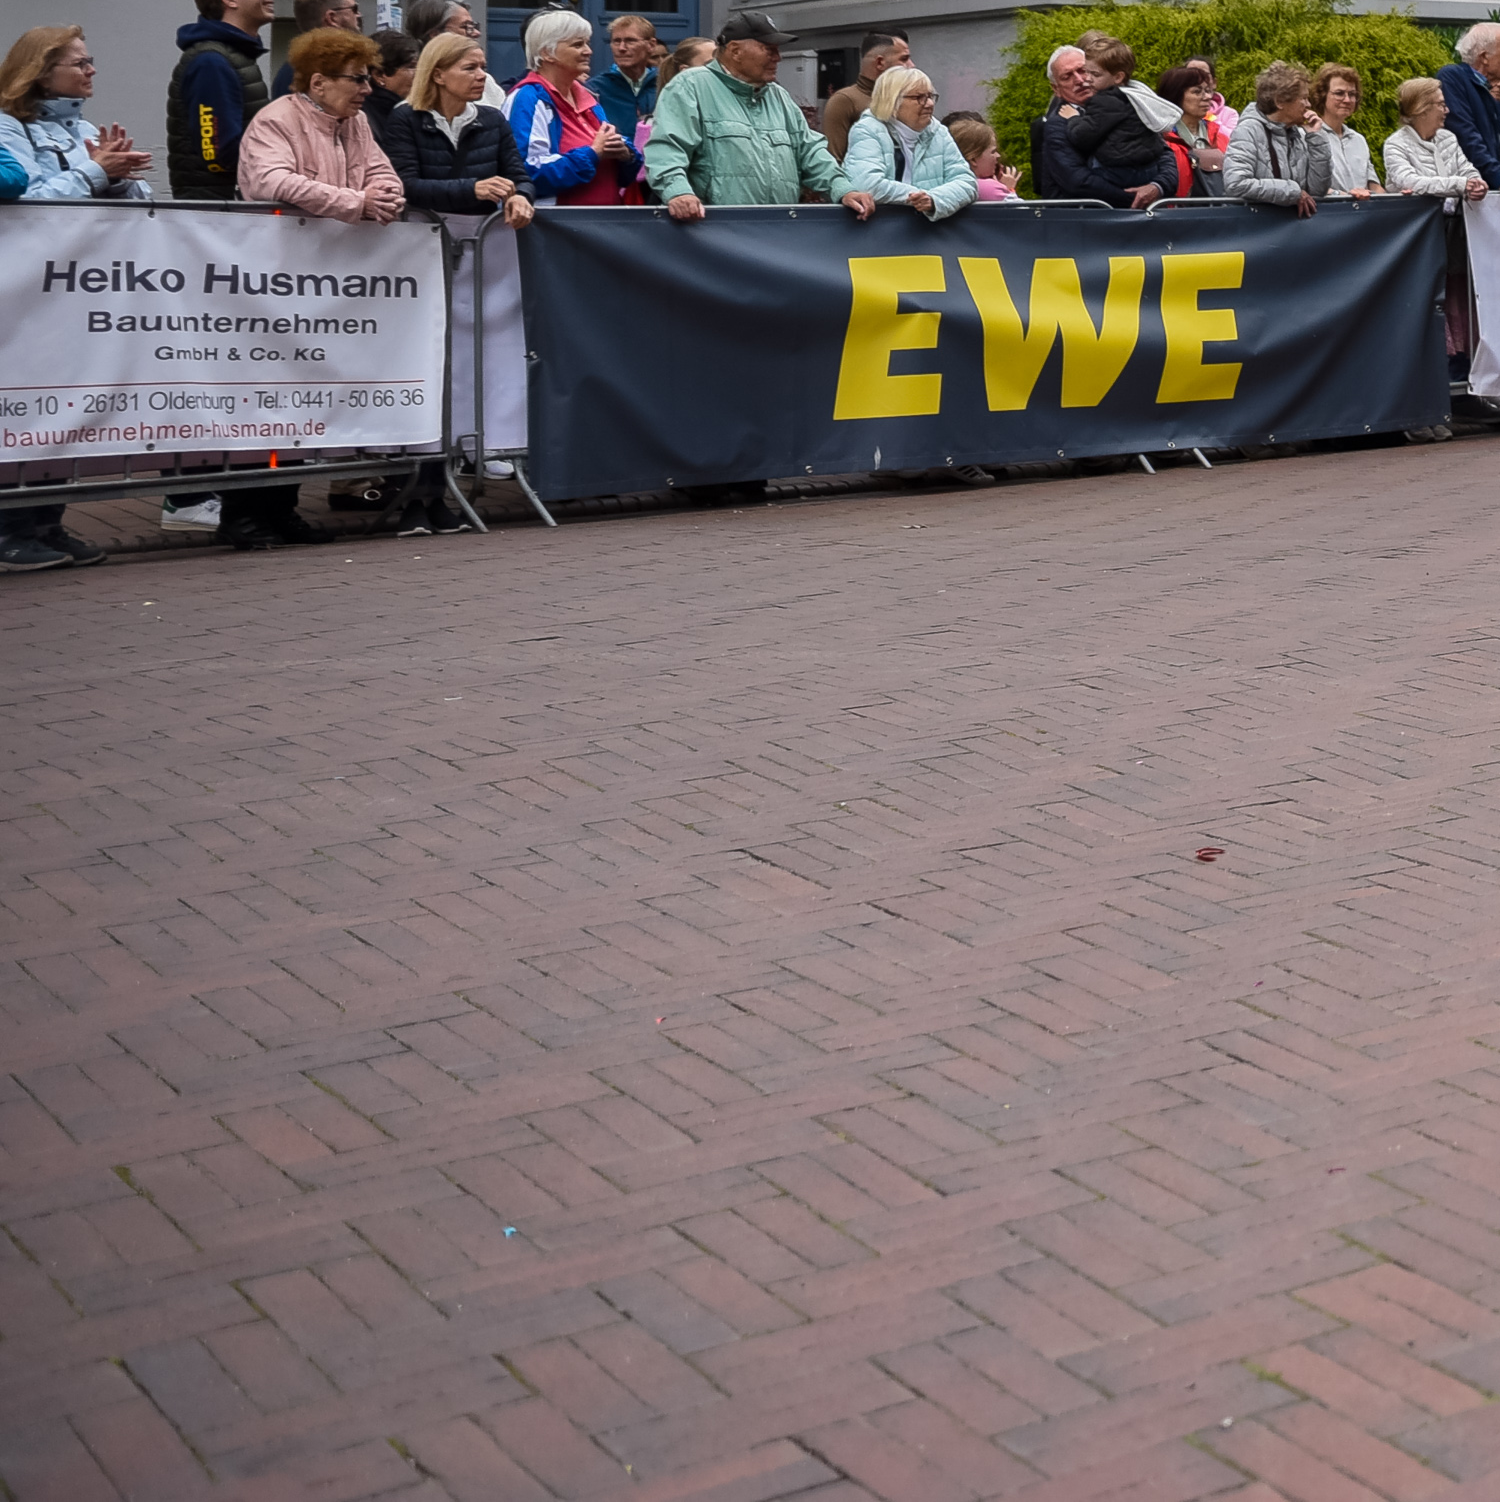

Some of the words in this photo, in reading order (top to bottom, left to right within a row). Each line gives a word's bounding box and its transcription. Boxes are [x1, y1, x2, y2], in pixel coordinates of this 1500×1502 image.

[199, 103, 215, 161] SPORT
[42, 260, 186, 293] Heiko
[203, 262, 419, 299] Husmann
[87, 311, 378, 335] Bauunternehmen
[832, 251, 1245, 421] EWE
[154, 346, 219, 362] GmbH
[227, 348, 241, 362] &
[249, 347, 287, 362] Co.
[294, 347, 327, 362] KG
[0, 397, 28, 417] ke
[35, 395, 59, 416] 10
[83, 392, 139, 414] 26131
[148, 390, 236, 415] Oldenburg
[291, 390, 333, 409] 0441
[372, 389, 395, 408] 66
[400, 388, 425, 407] 36
